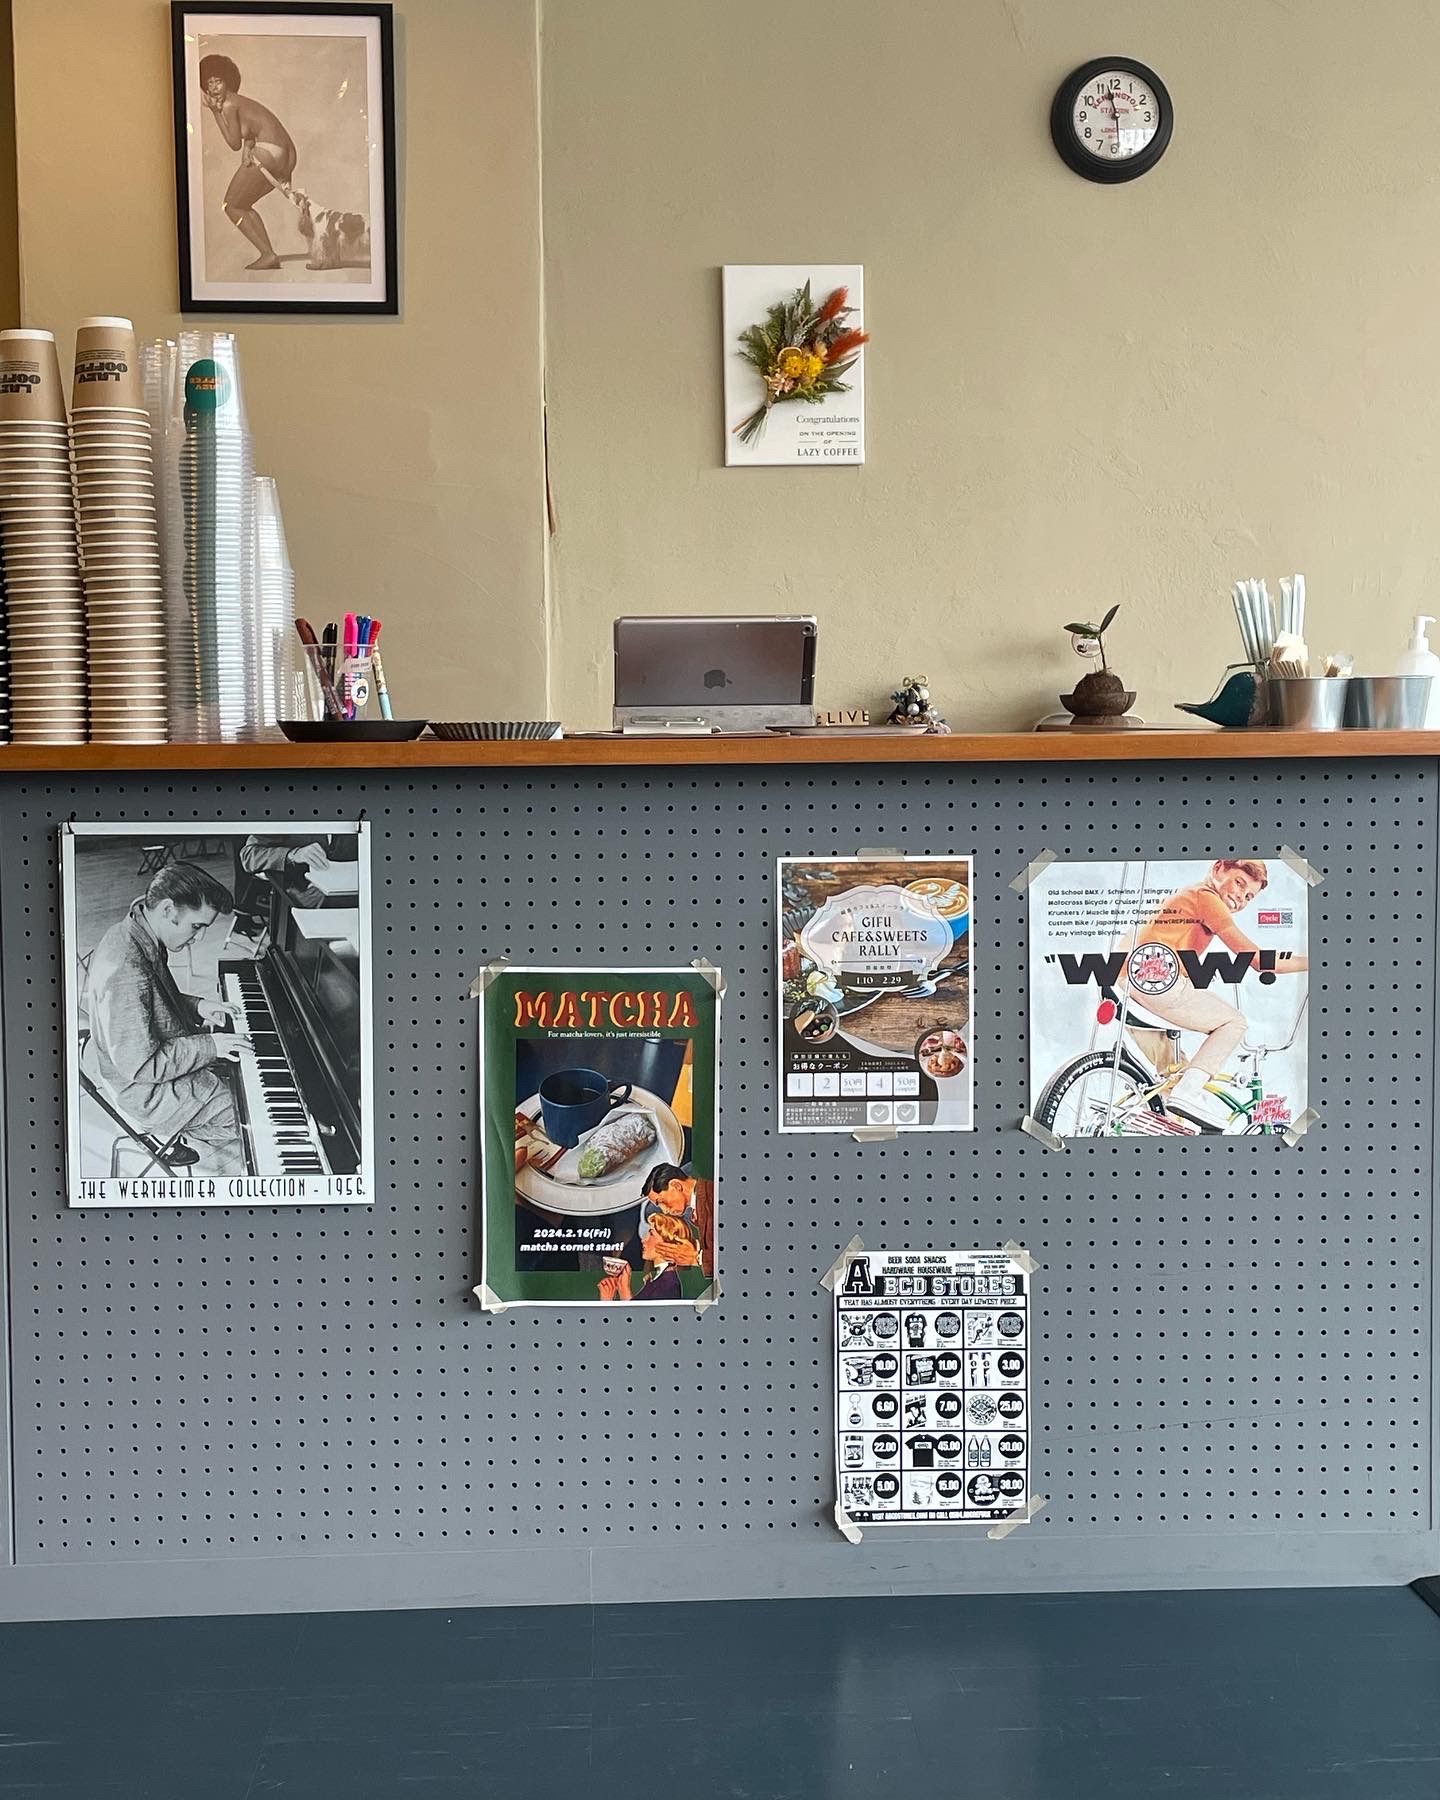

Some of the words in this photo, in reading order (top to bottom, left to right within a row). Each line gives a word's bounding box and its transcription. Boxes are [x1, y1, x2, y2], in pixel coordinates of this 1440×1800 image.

[1096, 83, 1105, 94] 11
[1109, 78, 1121, 90] 12
[1128, 82, 1133, 94] 1
[1083, 95, 1094, 106] 10
[1138, 94, 1147, 105] 2
[1079, 110, 1087, 122] 9
[1143, 111, 1152, 122] 3
[1084, 127, 1092, 138] 8
[1096, 139, 1104, 151] 7
[1110, 143, 1119, 154] 6
[796, 415, 860, 426] Congratulations
[797, 448, 821, 457] LAZY
[823, 447, 859, 456] COFFEE
[1084, 899, 1108, 907] Bicycle
[861, 916, 892, 928] GIFU
[831, 930, 928, 943] CAFE&SWEETS
[859, 944, 901, 957] RALLY
[513, 991, 700, 1028] MATCHA
[547, 1030, 560, 1038] For
[605, 1030, 615, 1038] it's
[616, 1030, 628, 1039] just
[628, 1030, 662, 1038] irresistible
[792, 1062, 849, 1071] お得なクーポン
[823, 1077, 831, 1089] 2
[118, 1180, 216, 1200] WERTHEIMER
[228, 1178, 306, 1198] COLLECTION
[533, 1228, 612, 1239] 2024.2.16(Fri)
[520, 1241, 559, 1252] matcha
[560, 1242, 594, 1252] cornet
[595, 1242, 624, 1252] start!
[887, 1255, 902, 1264] BEER
[905, 1255, 921, 1264] SODA
[923, 1255, 947, 1264] SNACKS
[881, 1265, 915, 1275] HARDWARE
[917, 1265, 953, 1275] HOUSEWARE
[931, 1275, 1016, 1295] STORES
[874, 1359, 897, 1371] 10.00
[938, 1359, 959, 1371] 11.00
[1001, 1359, 1021, 1371] 3.00
[939, 1400, 959, 1412] 7.00
[999, 1400, 1023, 1412] 25.00
[873, 1440, 898, 1452] 22.00
[937, 1440, 962, 1452] 45.00
[999, 1440, 1023, 1452] 30.00
[876, 1480, 895, 1492] 5.00
[938, 1479, 960, 1491] 15.00
